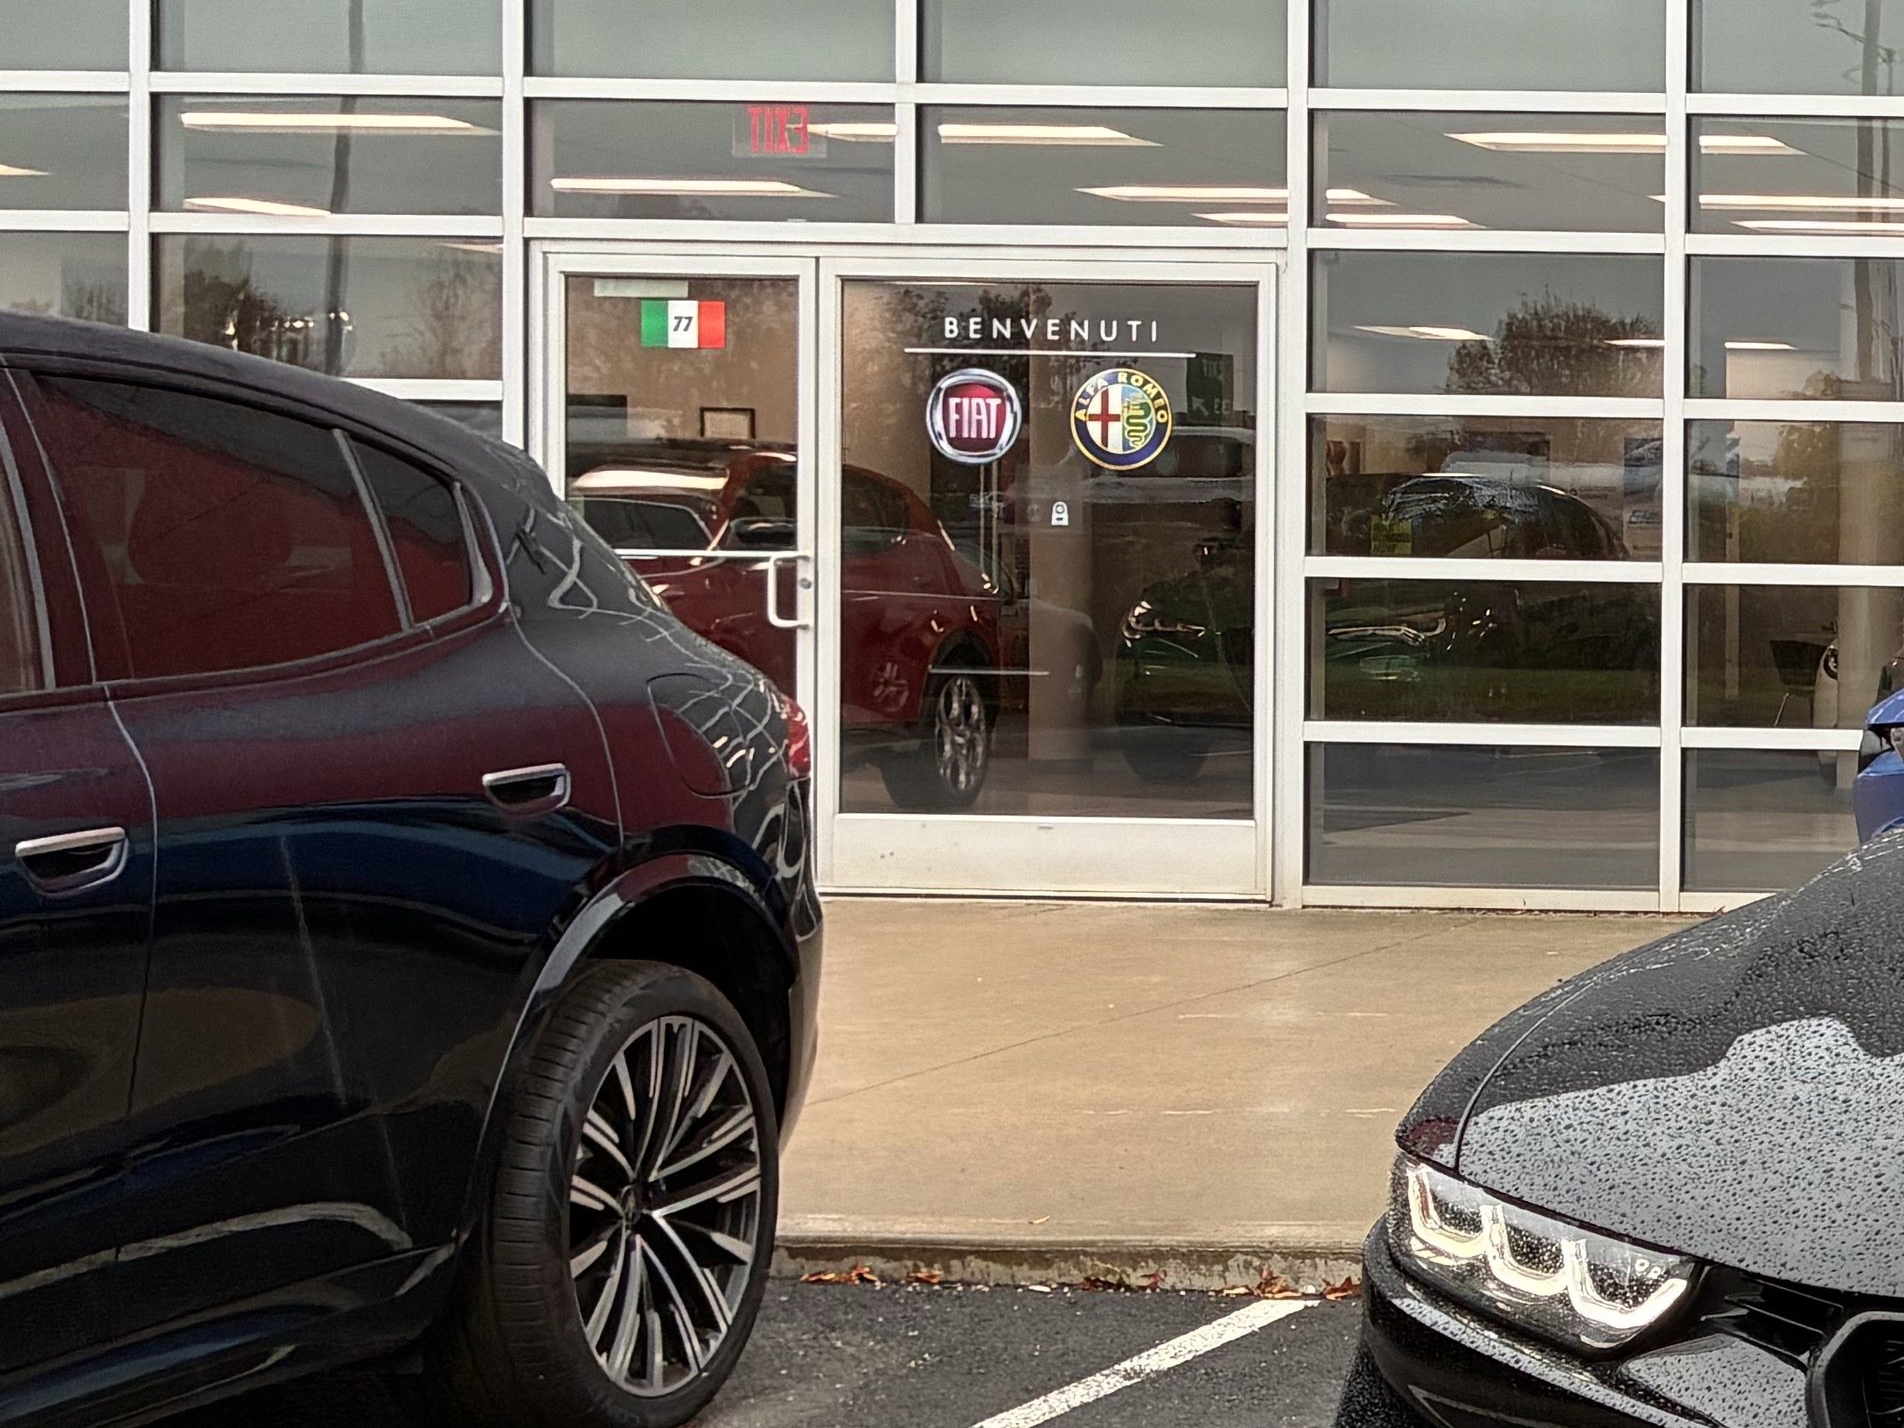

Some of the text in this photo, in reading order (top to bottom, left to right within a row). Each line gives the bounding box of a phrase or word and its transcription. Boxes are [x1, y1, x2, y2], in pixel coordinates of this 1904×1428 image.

[672, 315, 693, 332] 77
[944, 316, 1158, 343] BENVENUTI
[1073, 371, 1169, 424] ALFA ROMEO
[948, 396, 1002, 440] FIAT
